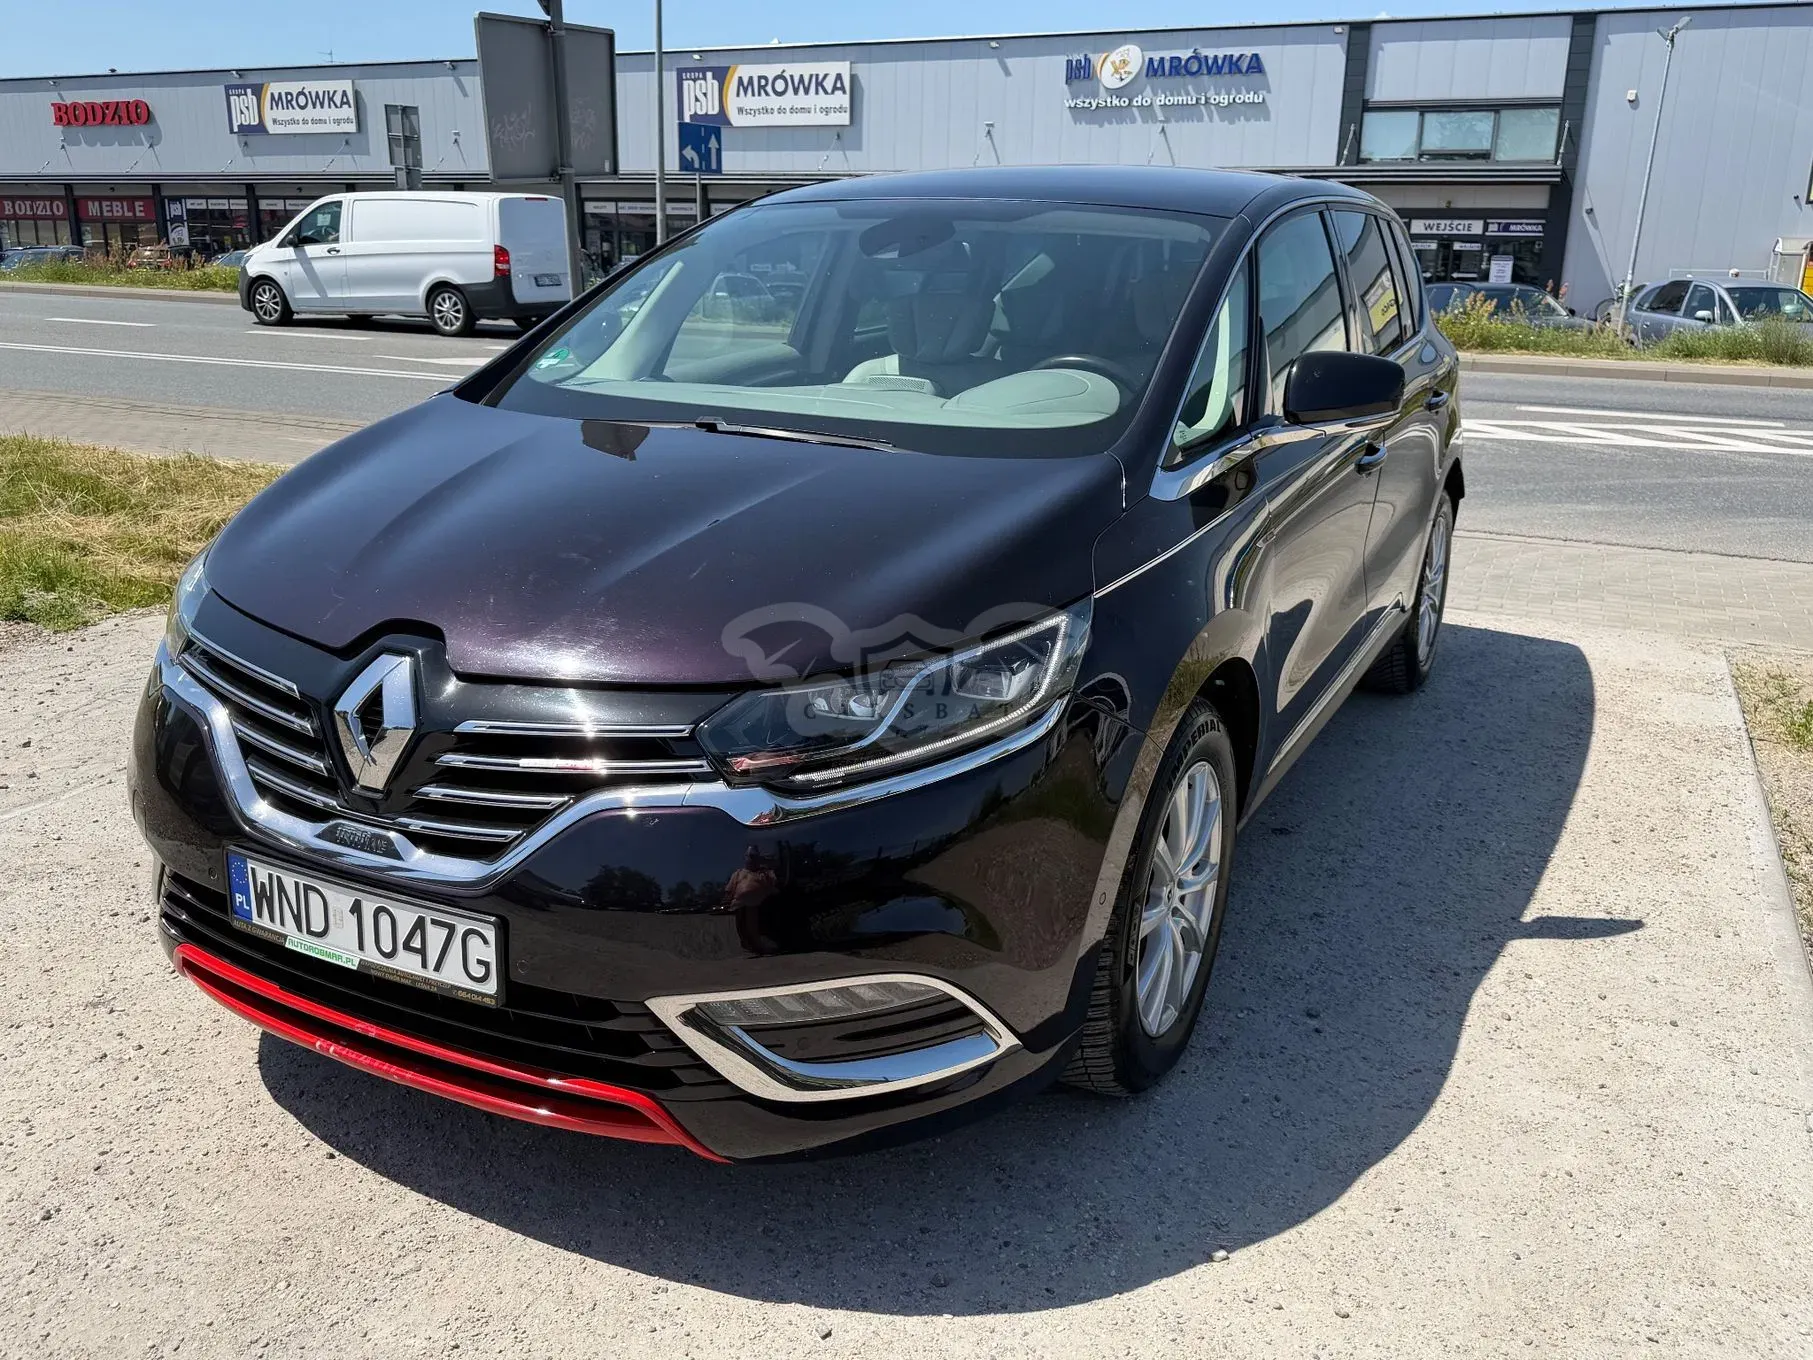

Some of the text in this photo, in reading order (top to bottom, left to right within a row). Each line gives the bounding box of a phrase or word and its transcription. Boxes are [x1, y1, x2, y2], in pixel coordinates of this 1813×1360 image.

[1065, 48, 1264, 85] psb MRÓWKA
[736, 69, 847, 97] MRÓWKA
[270, 86, 352, 110] MRÓWKA
[682, 71, 719, 122] psb
[1064, 91, 1263, 110] wszystko do domu i ogrodu
[51, 99, 150, 126] BODZIO
[230, 88, 259, 132] psb
[737, 106, 774, 117] Wszystko
[777, 105, 787, 114] do
[789, 104, 811, 114] domu
[818, 104, 848, 115] ogrodu
[272, 117, 300, 127] Wszystko
[3, 200, 64, 216] BODZIO
[87, 200, 146, 217] MEBLE
[1423, 219, 1473, 232] WEJŚCIE
[235, 892, 250, 910] PL
[250, 866, 491, 984] WND 1047G
